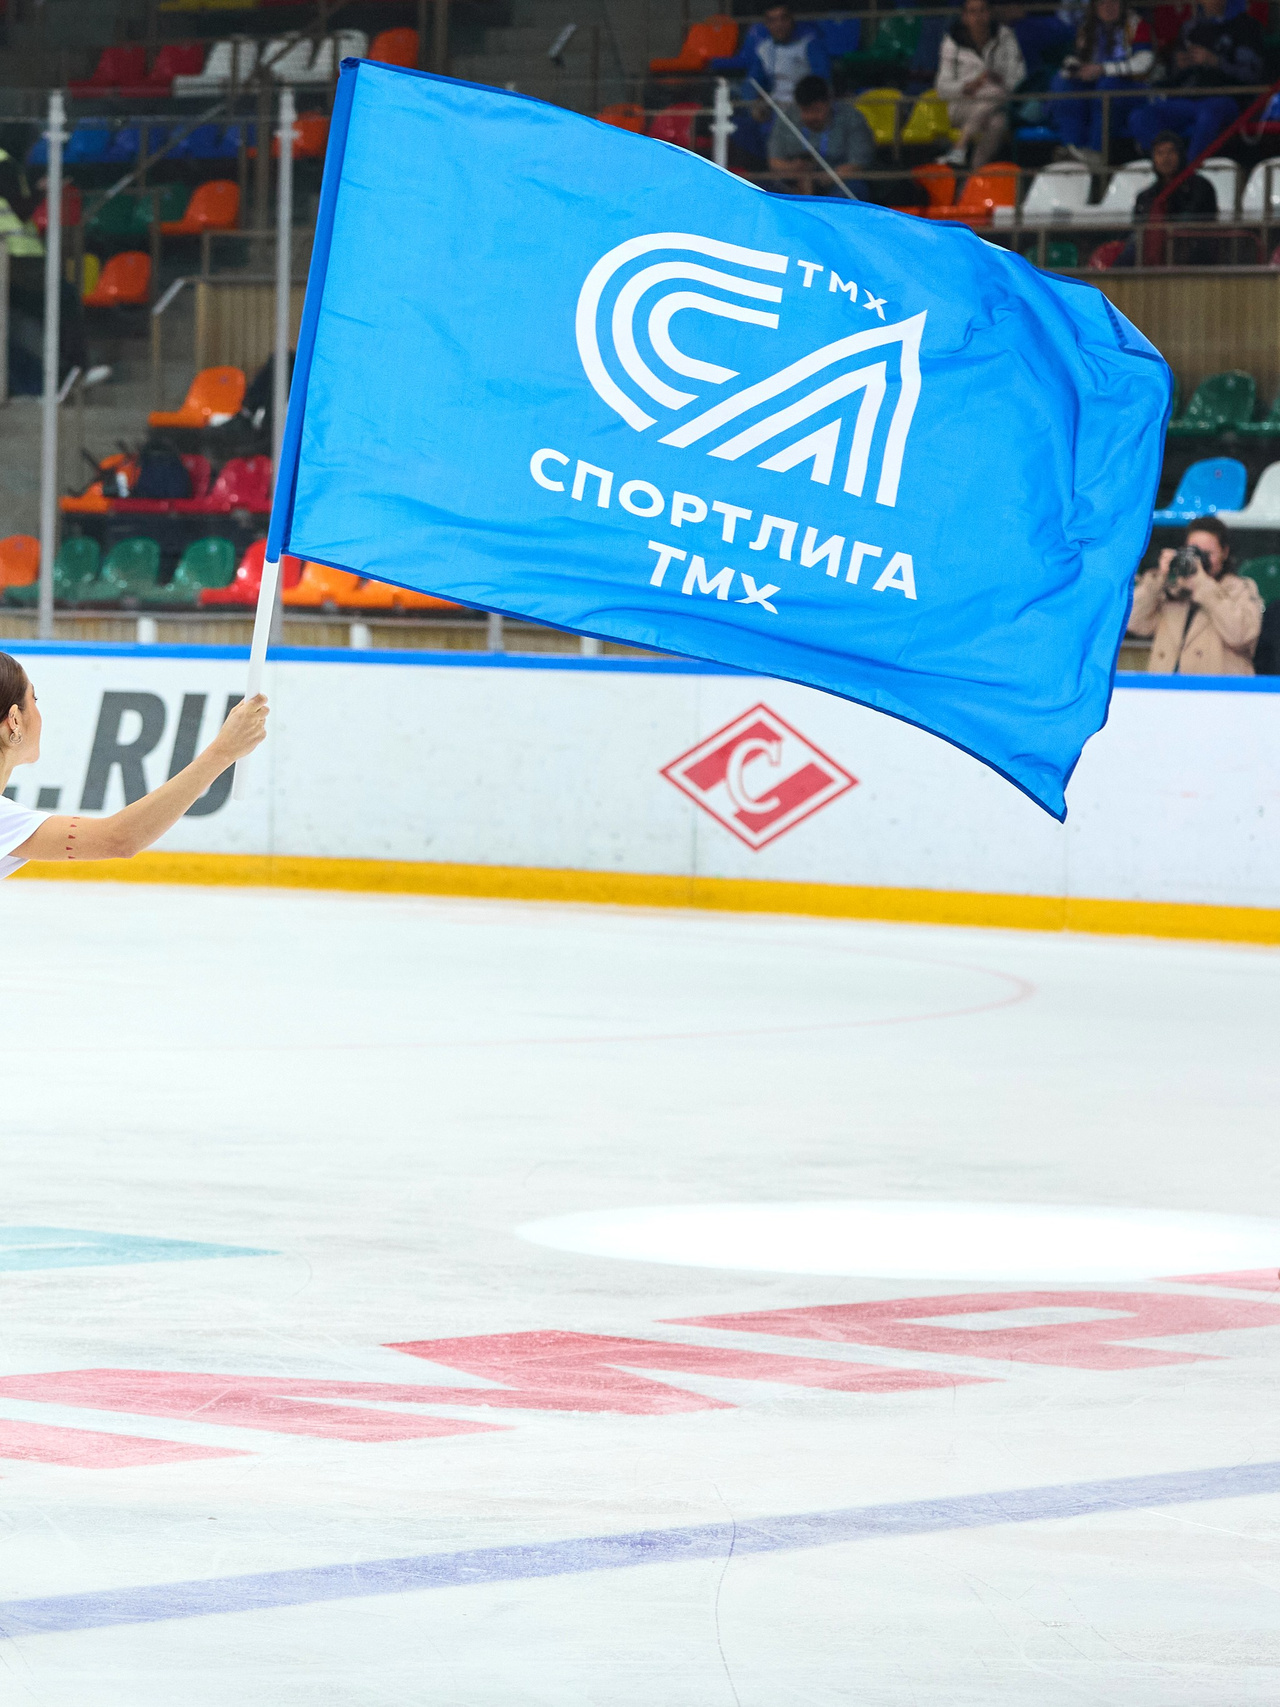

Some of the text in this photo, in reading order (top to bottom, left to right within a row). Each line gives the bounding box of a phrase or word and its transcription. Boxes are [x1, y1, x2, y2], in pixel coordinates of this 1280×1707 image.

[797, 259, 888, 320] ТМХ
[530, 447, 917, 600] СПОРТЛИГА
[647, 540, 781, 614] ТМХ
